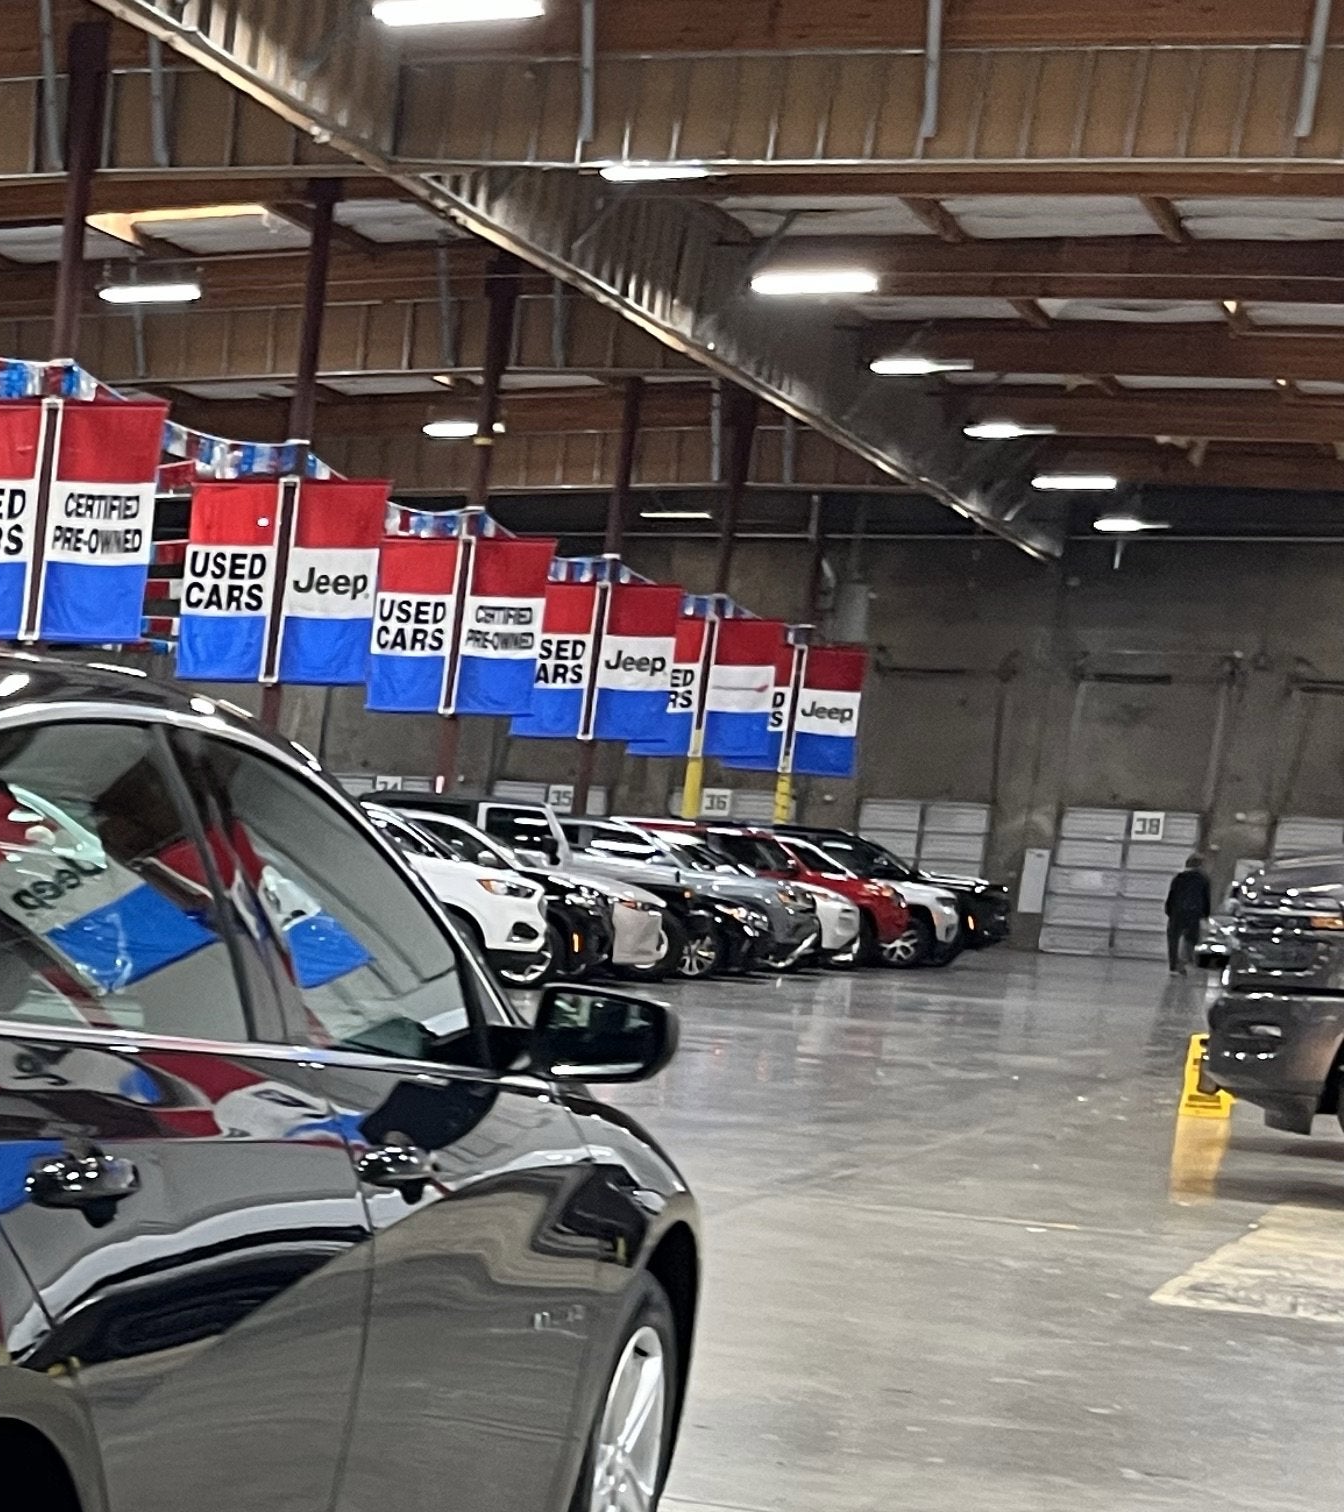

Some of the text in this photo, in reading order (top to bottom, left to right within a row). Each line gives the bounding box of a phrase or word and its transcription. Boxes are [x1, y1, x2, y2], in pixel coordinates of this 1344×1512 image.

[64, 492, 140, 520] CERTIFIED
[52, 525, 143, 554] PRE-OWNED
[190, 551, 267, 581] USED
[292, 566, 369, 601] Jeep
[185, 582, 264, 612] CARS
[379, 598, 447, 625] USED
[376, 626, 445, 651] CARS
[538, 639, 586, 661] SED
[534, 663, 583, 684] ARS
[604, 650, 667, 677] Jeep
[670, 668, 695, 688] ED
[667, 690, 693, 708] RS
[801, 701, 854, 724] Jeep
[551, 790, 572, 806] 35
[704, 794, 728, 811] 36
[1134, 817, 1161, 836] 38
